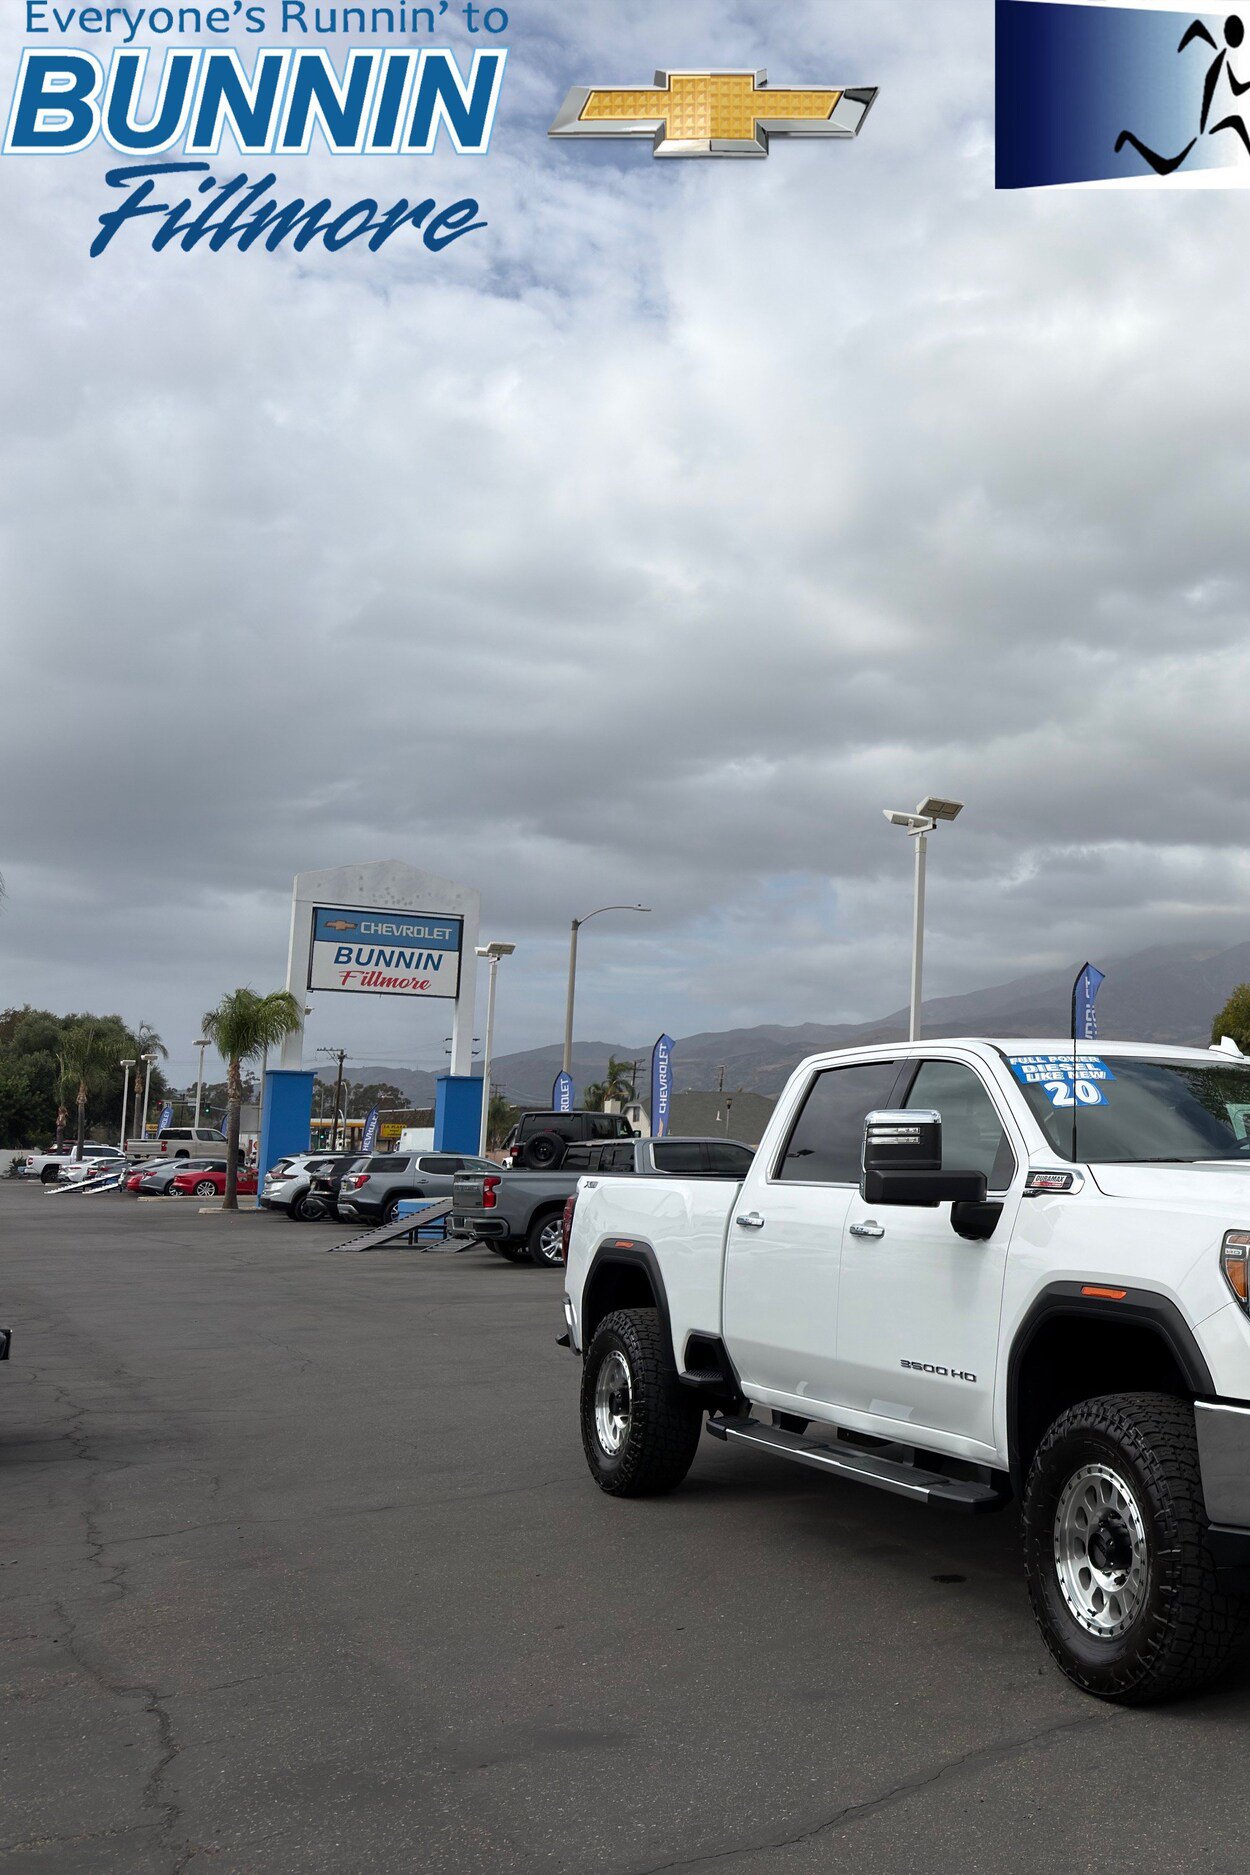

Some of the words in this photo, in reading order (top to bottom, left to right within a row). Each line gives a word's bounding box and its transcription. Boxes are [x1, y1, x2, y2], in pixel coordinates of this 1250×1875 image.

[360, 922, 452, 940] CHEVROLET
[333, 946, 443, 972] BUNNIN
[338, 970, 432, 991] Fillmore
[1009, 1057, 1047, 1065] FULL
[1047, 1055, 1101, 1063] POWER
[1021, 1063, 1101, 1073] DIESEL
[658, 1042, 669, 1114] CHEVROLET
[1026, 1070, 1065, 1082] LIKE
[1043, 1080, 1102, 1106] 20
[900, 1359, 948, 1377] 3500
[951, 1368, 977, 1383] HD
